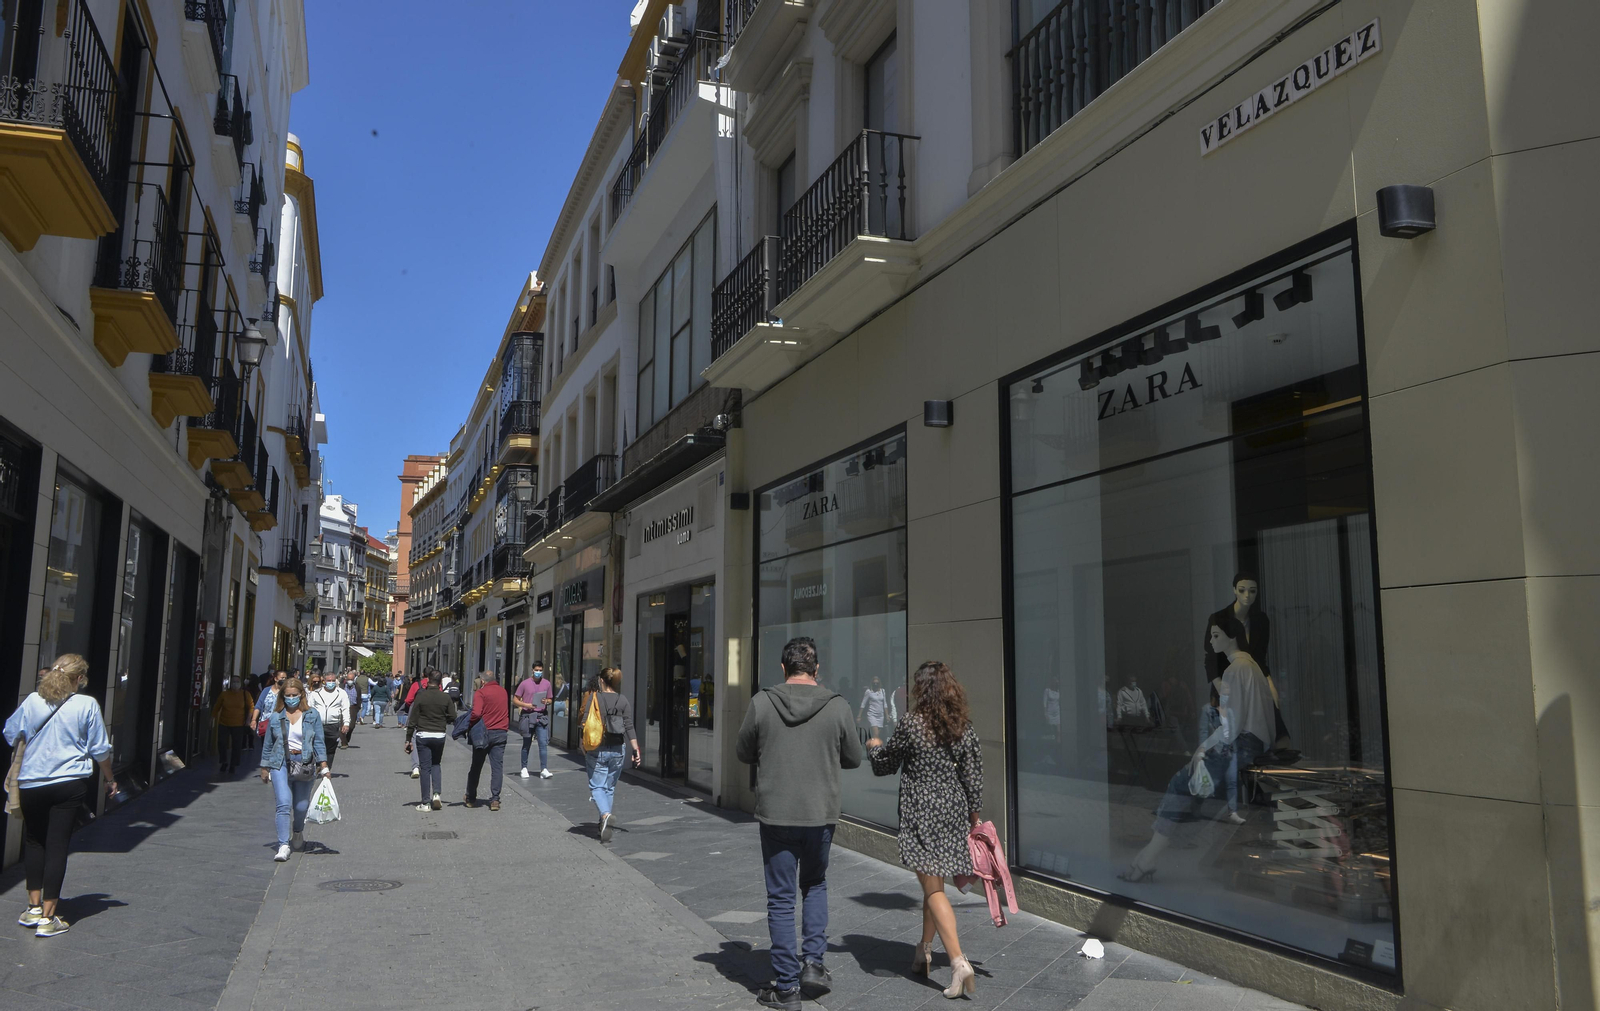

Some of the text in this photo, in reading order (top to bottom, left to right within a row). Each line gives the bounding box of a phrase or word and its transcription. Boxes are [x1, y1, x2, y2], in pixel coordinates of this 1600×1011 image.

[1201, 22, 1377, 150] VELAZQUEZ
[1097, 361, 1203, 421] ZARA
[802, 493, 840, 520] ZARA
[193, 623, 206, 706] LA TEATRAL
